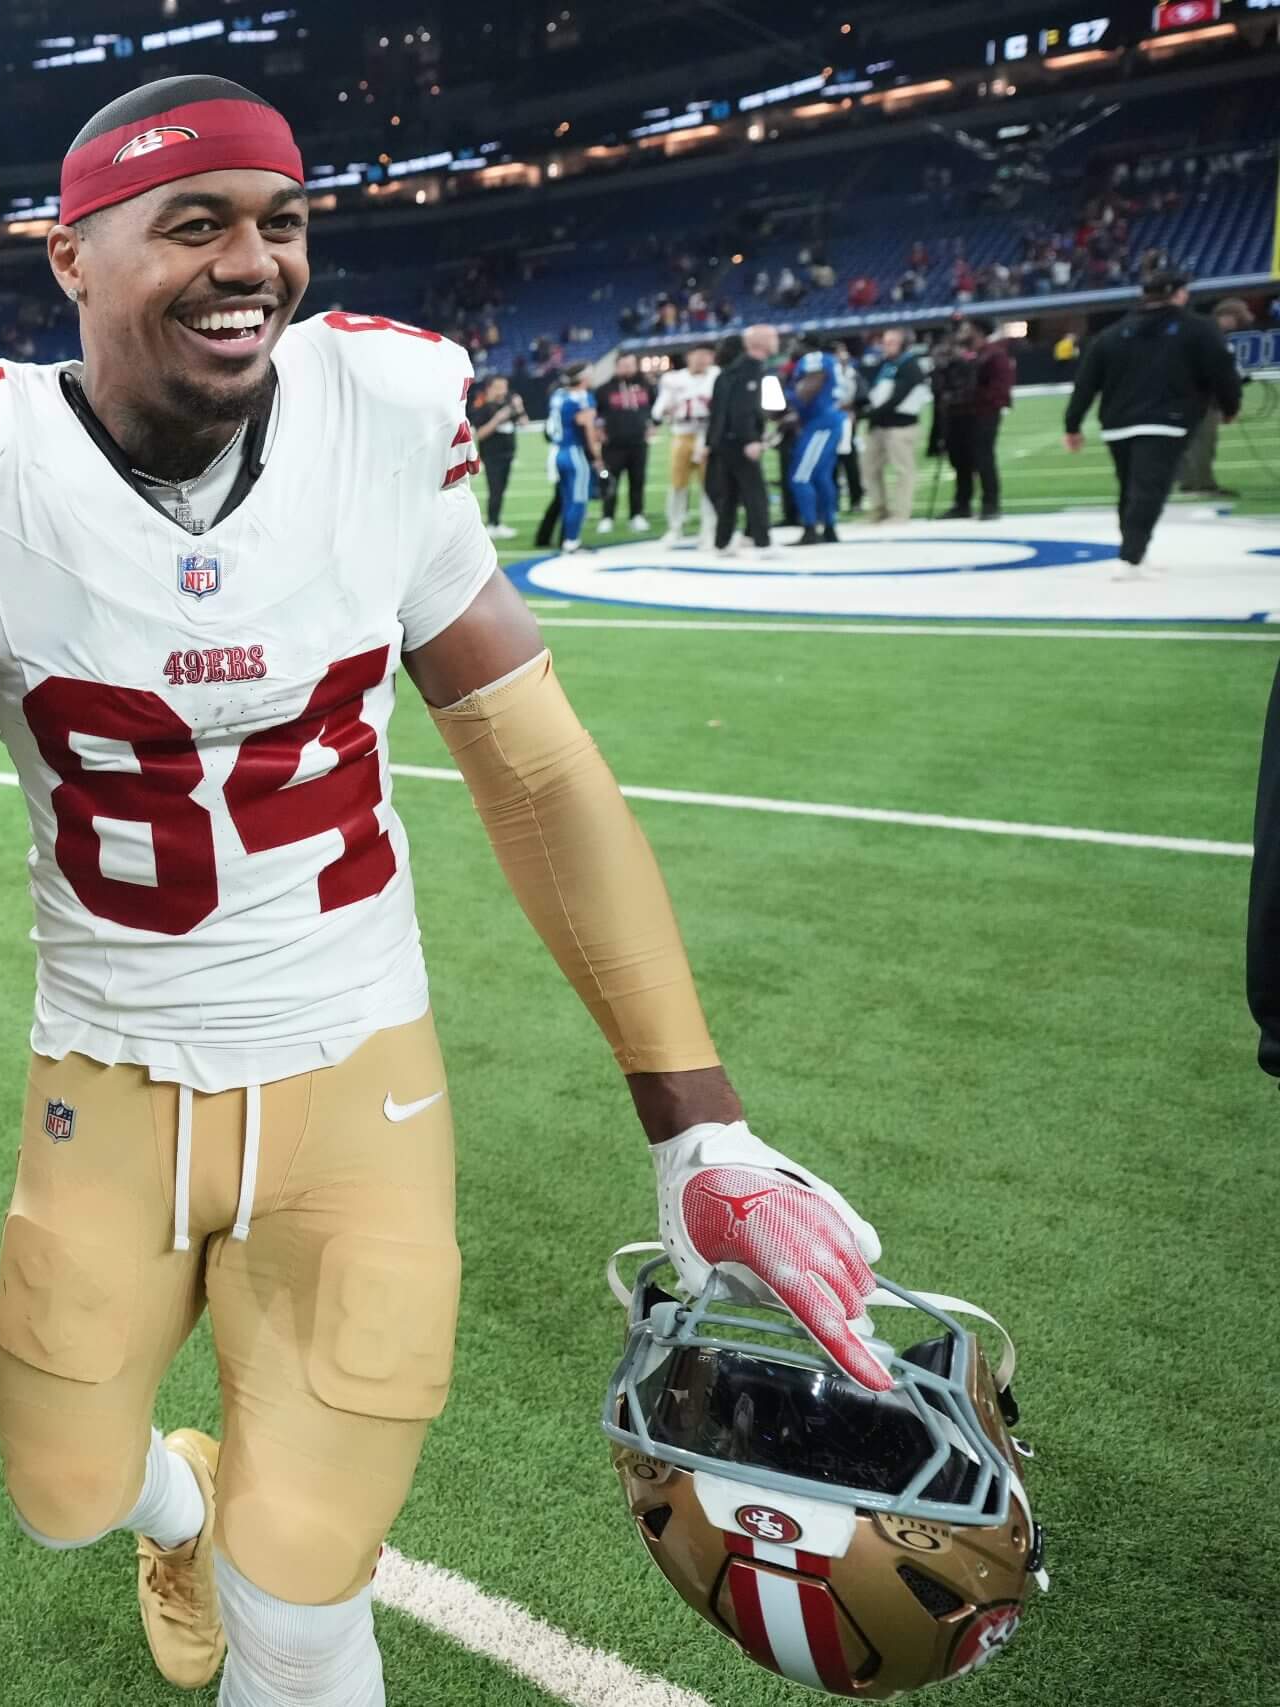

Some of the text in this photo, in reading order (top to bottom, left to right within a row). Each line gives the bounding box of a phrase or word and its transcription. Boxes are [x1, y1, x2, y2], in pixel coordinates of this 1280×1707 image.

[1068, 18, 1110, 47] 27
[184, 570, 215, 592] NFL
[163, 645, 267, 685] 49ERS
[22, 643, 397, 936] 84
[47, 1115, 69, 1136] NFL
[886, 1514, 950, 1539] OAKLEY
